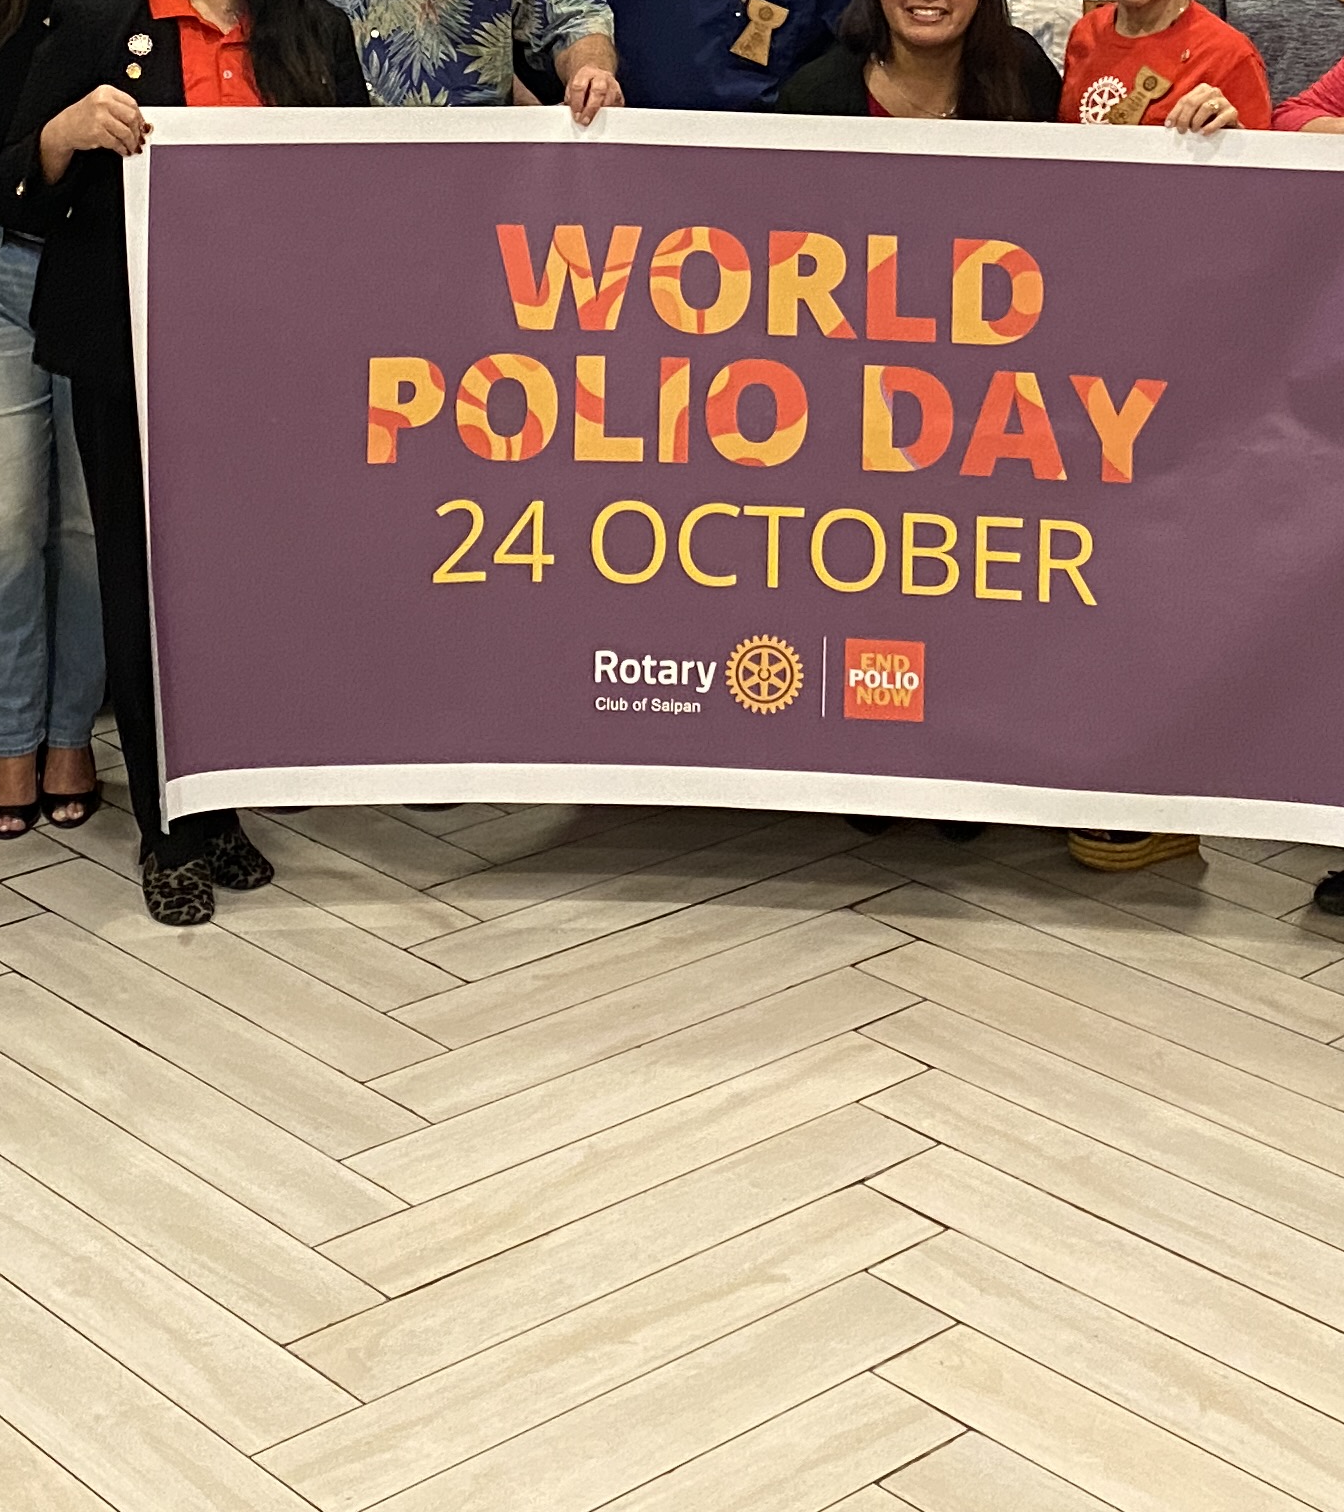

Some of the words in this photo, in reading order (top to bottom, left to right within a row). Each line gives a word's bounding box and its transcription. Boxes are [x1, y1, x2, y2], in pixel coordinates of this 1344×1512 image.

[496, 223, 1045, 346] WORLD
[367, 353, 809, 468] POLIO
[861, 363, 1168, 485] DAY
[432, 498, 555, 584] 24
[591, 499, 1098, 606] OCTOBER
[594, 649, 718, 694] Rotary
[849, 668, 920, 691] POLIO
[860, 652, 911, 674] END
[595, 696, 629, 712] Club
[632, 697, 648, 712] of
[650, 697, 701, 716] Saipan
[856, 686, 914, 708] NOW
